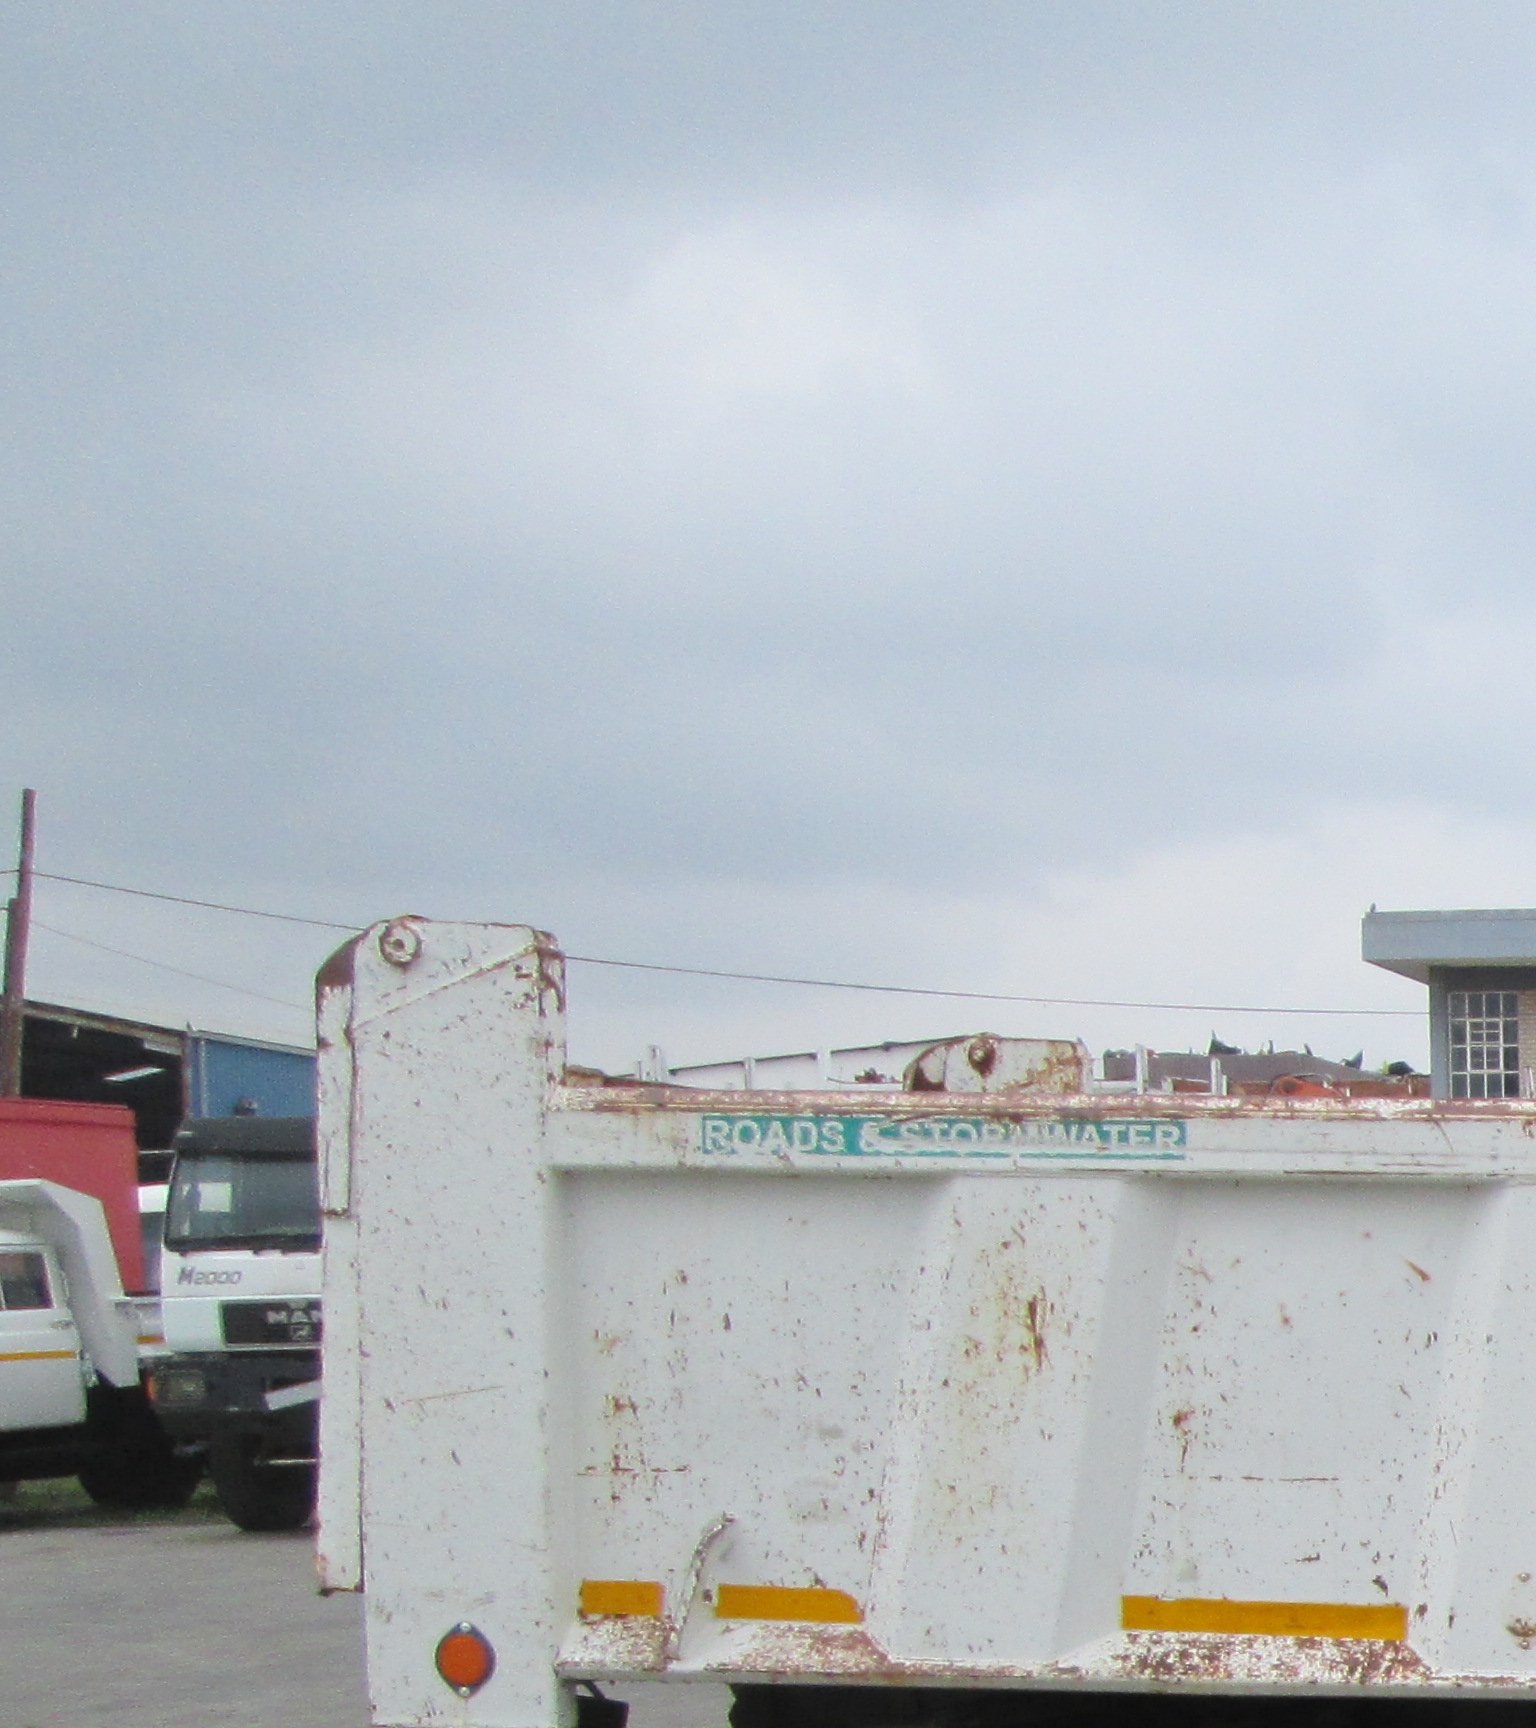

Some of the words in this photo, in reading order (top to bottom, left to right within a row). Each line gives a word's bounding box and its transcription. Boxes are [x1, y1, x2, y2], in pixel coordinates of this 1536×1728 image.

[704, 1119, 846, 1153] ROADS
[900, 1119, 1183, 1149] STORMWATER
[177, 1265, 243, 1286] M2000
